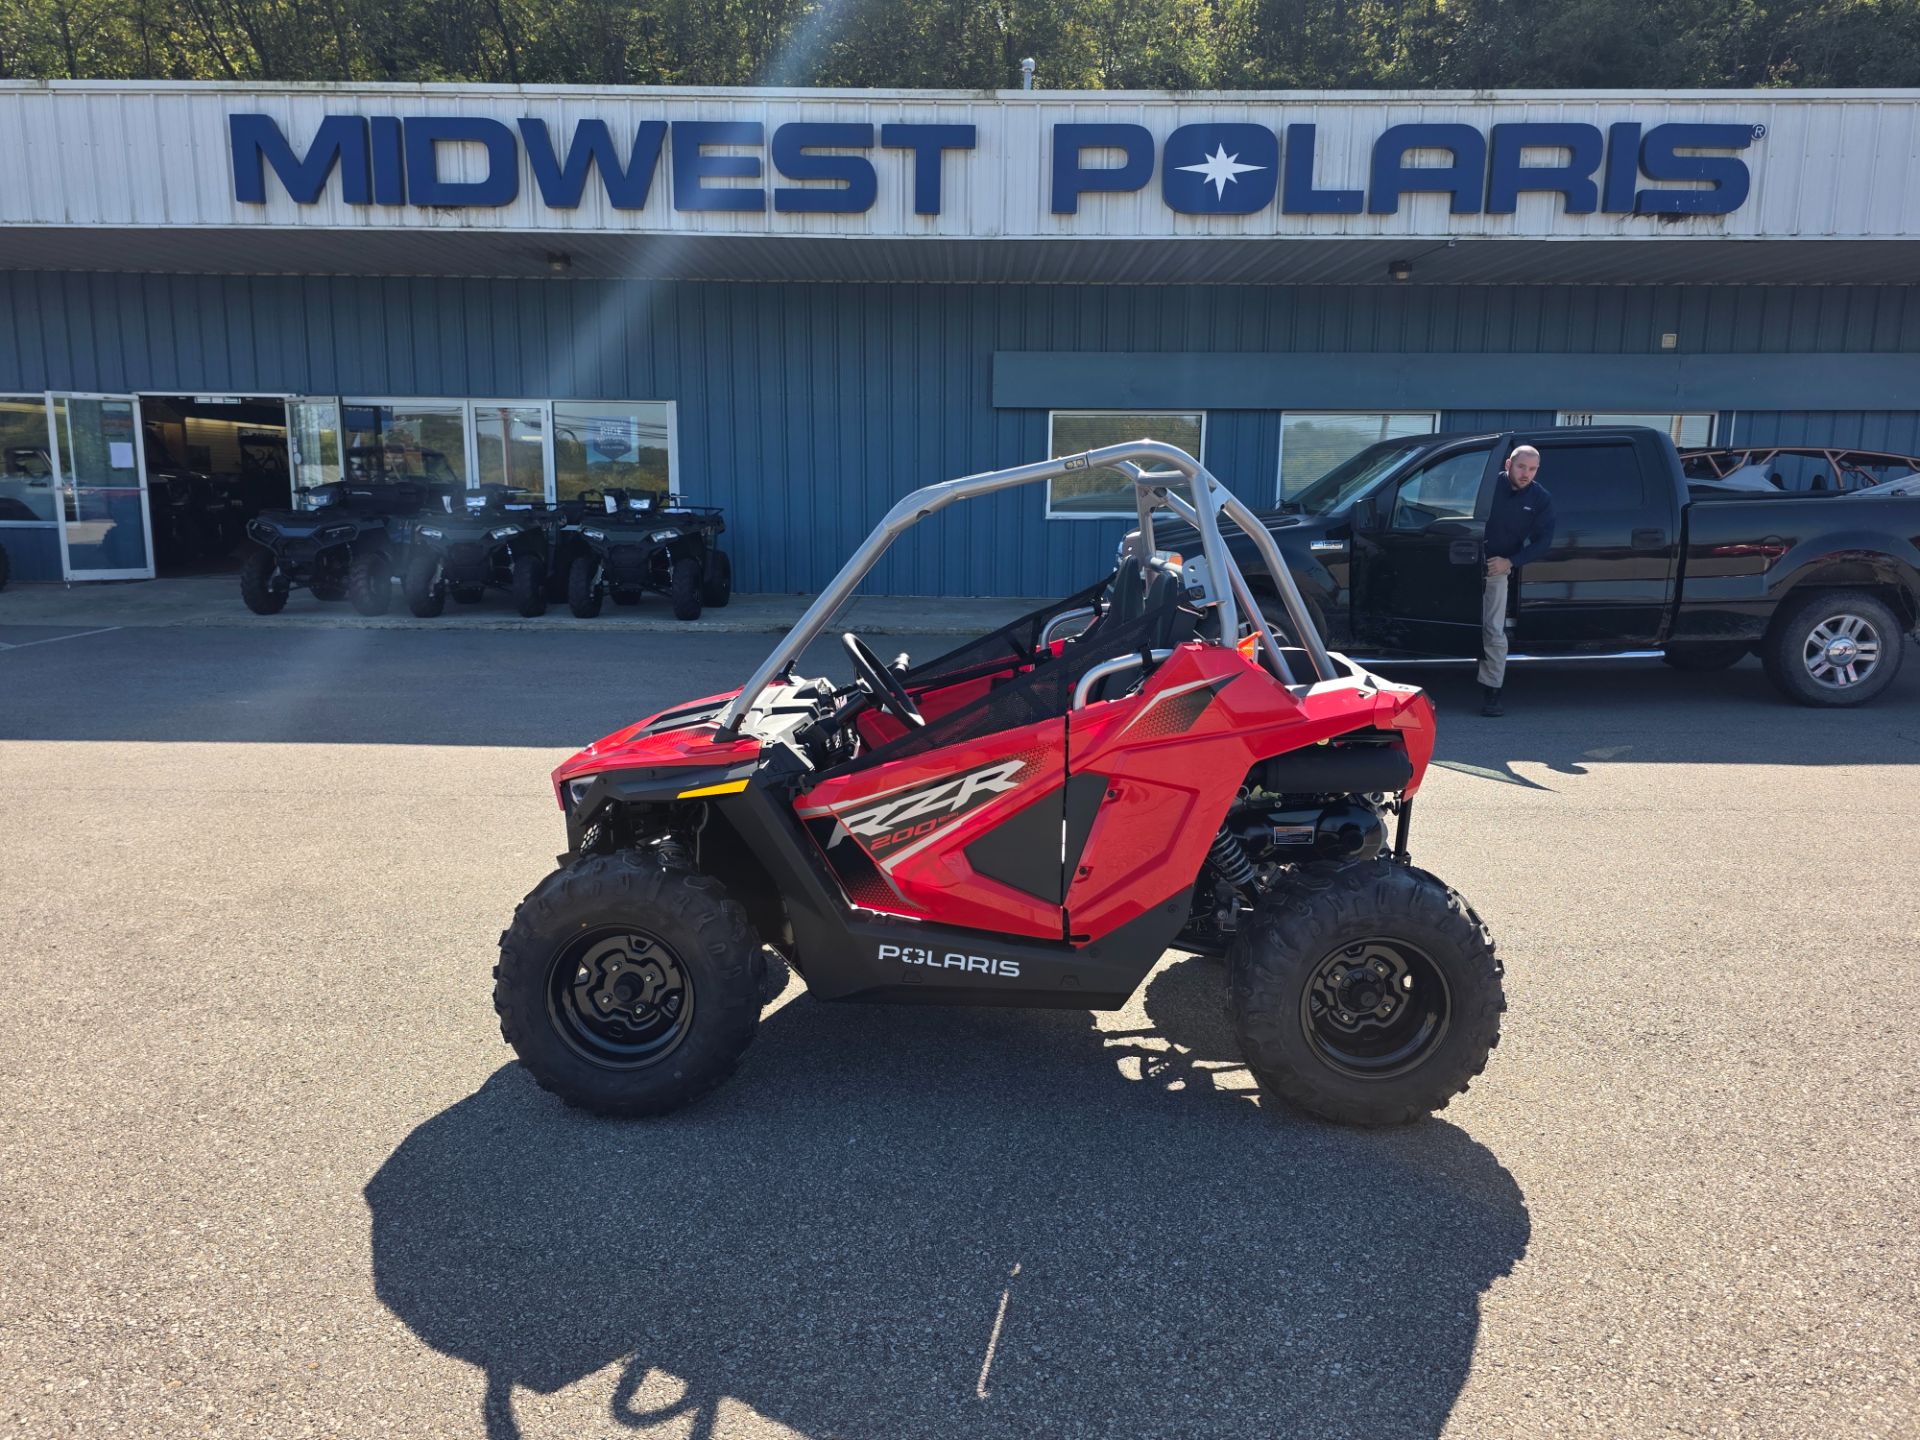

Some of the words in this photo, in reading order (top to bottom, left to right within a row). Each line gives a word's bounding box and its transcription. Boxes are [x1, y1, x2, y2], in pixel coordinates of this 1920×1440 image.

[229, 113, 977, 215] MIDWEST
[826, 759, 1027, 850] RZR
[870, 818, 937, 850] 200
[877, 944, 1020, 978] POLARIS
